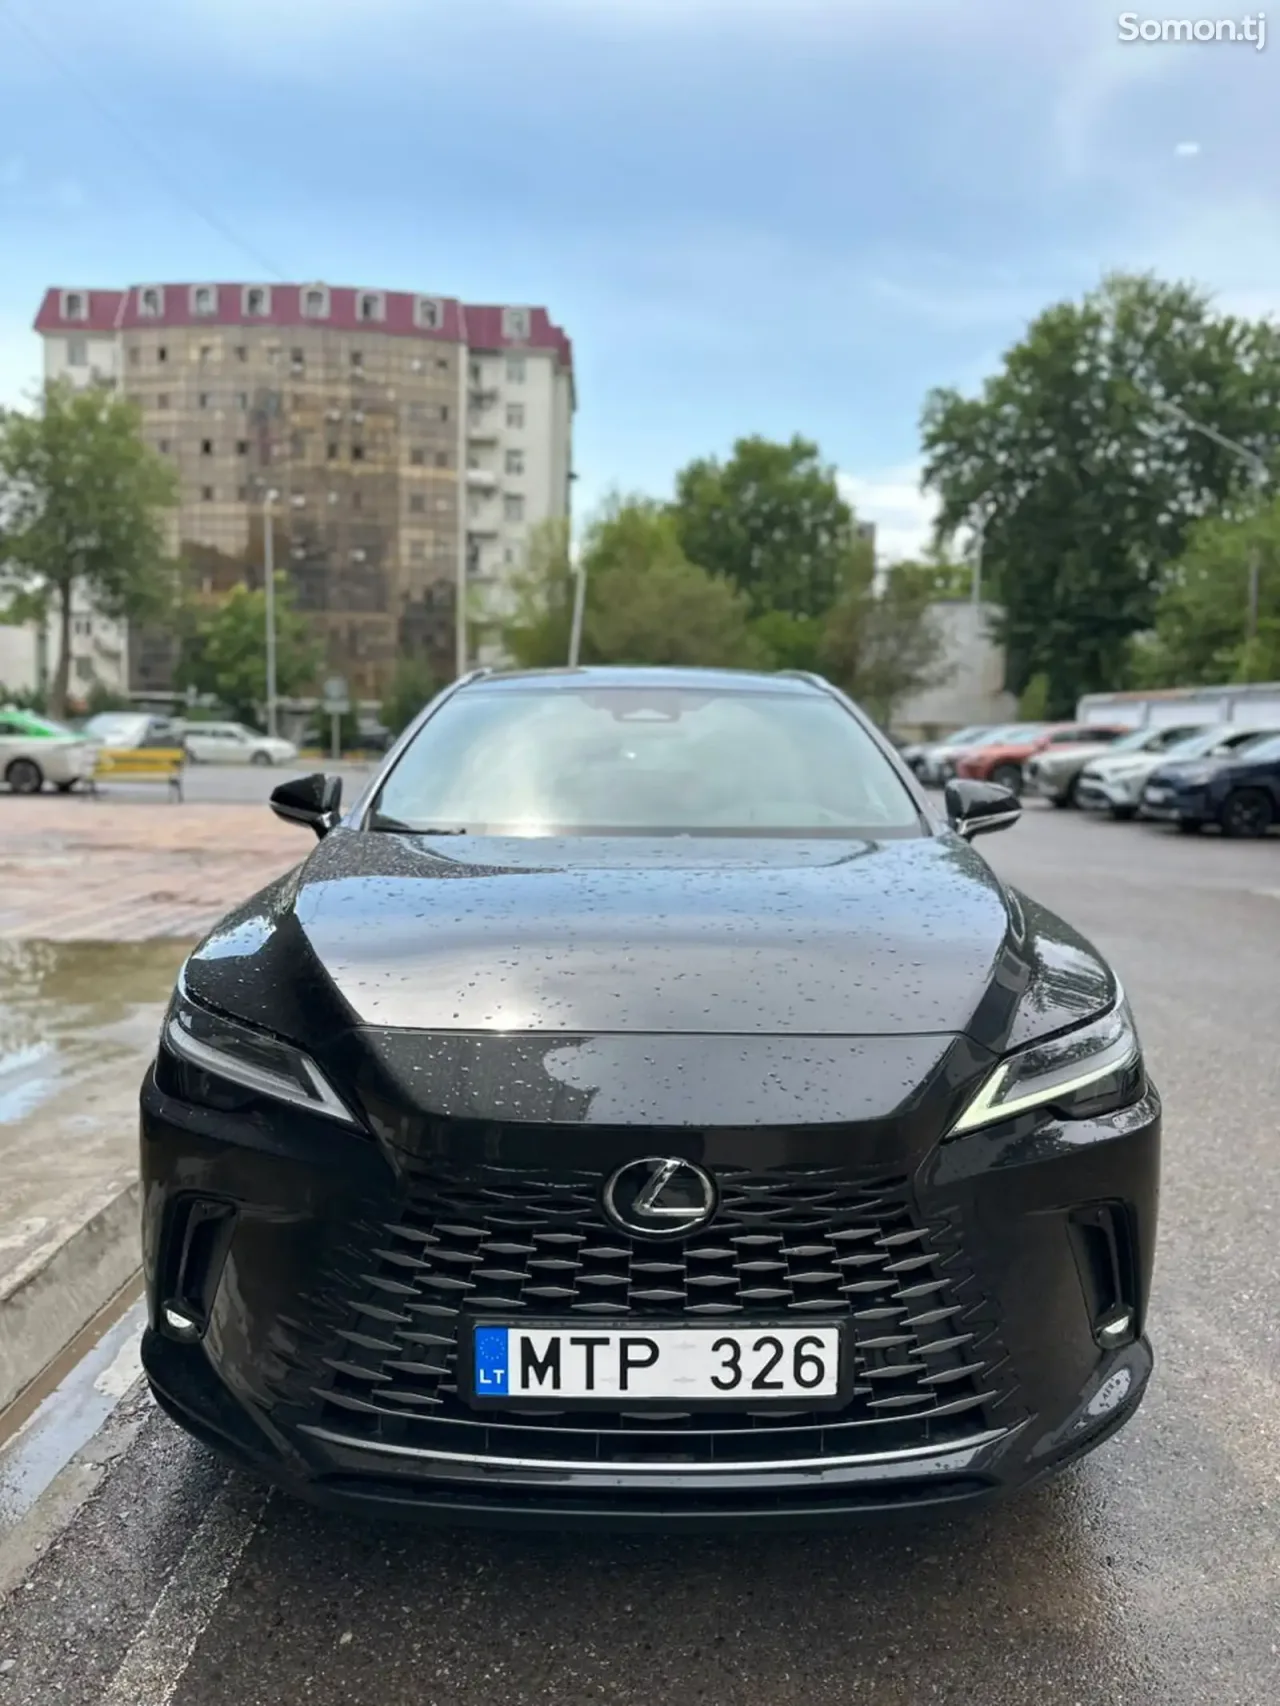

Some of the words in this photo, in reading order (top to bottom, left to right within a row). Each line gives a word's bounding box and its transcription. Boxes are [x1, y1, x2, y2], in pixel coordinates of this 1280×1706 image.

[480, 1369, 505, 1384] LT
[520, 1337, 660, 1390] MTP
[711, 1336, 826, 1390] 326
